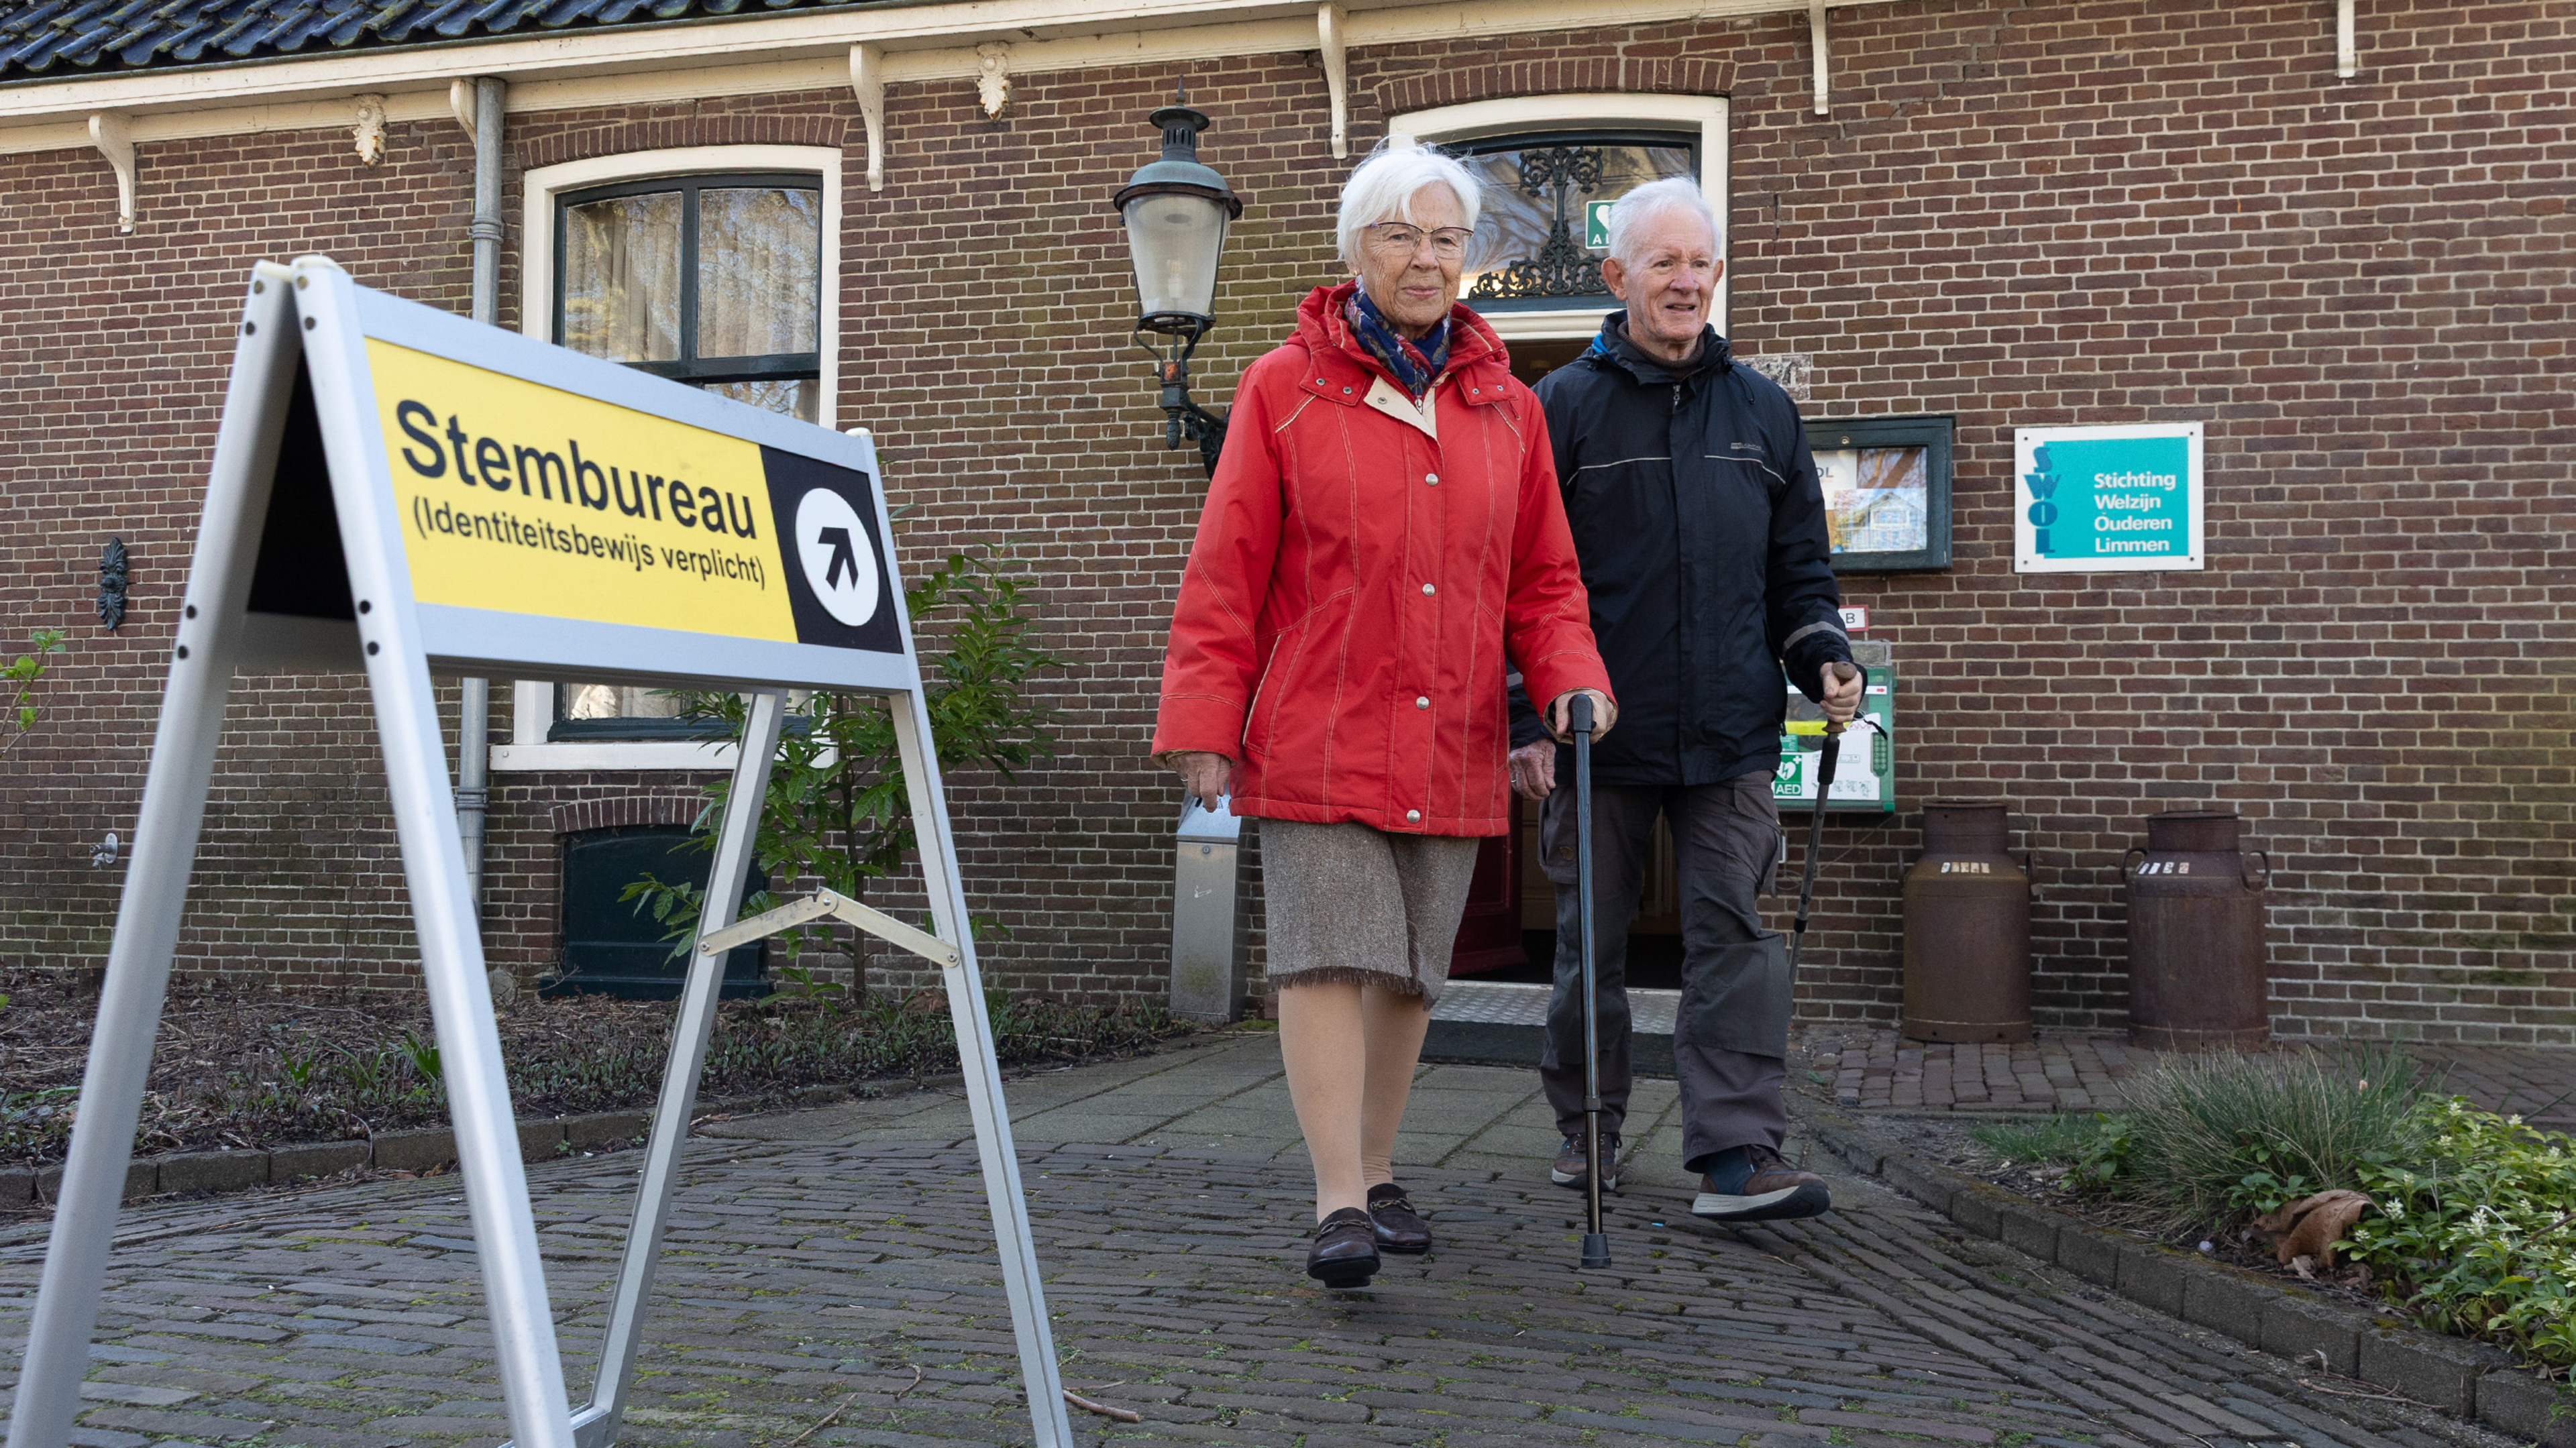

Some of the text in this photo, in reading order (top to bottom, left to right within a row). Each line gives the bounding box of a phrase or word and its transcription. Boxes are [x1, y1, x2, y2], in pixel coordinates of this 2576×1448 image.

[397, 400, 757, 539] Stembureau
[2094, 471, 2176, 491] Stichting
[2023, 447, 2061, 555] SWOL
[2094, 494, 2161, 512] Welzijn
[2094, 515, 2173, 531] Ouderen
[414, 496, 765, 591] (Identiteitsbewijs verplicht)
[2095, 538, 2170, 553] Limmen
[1775, 783, 1801, 795] AED
